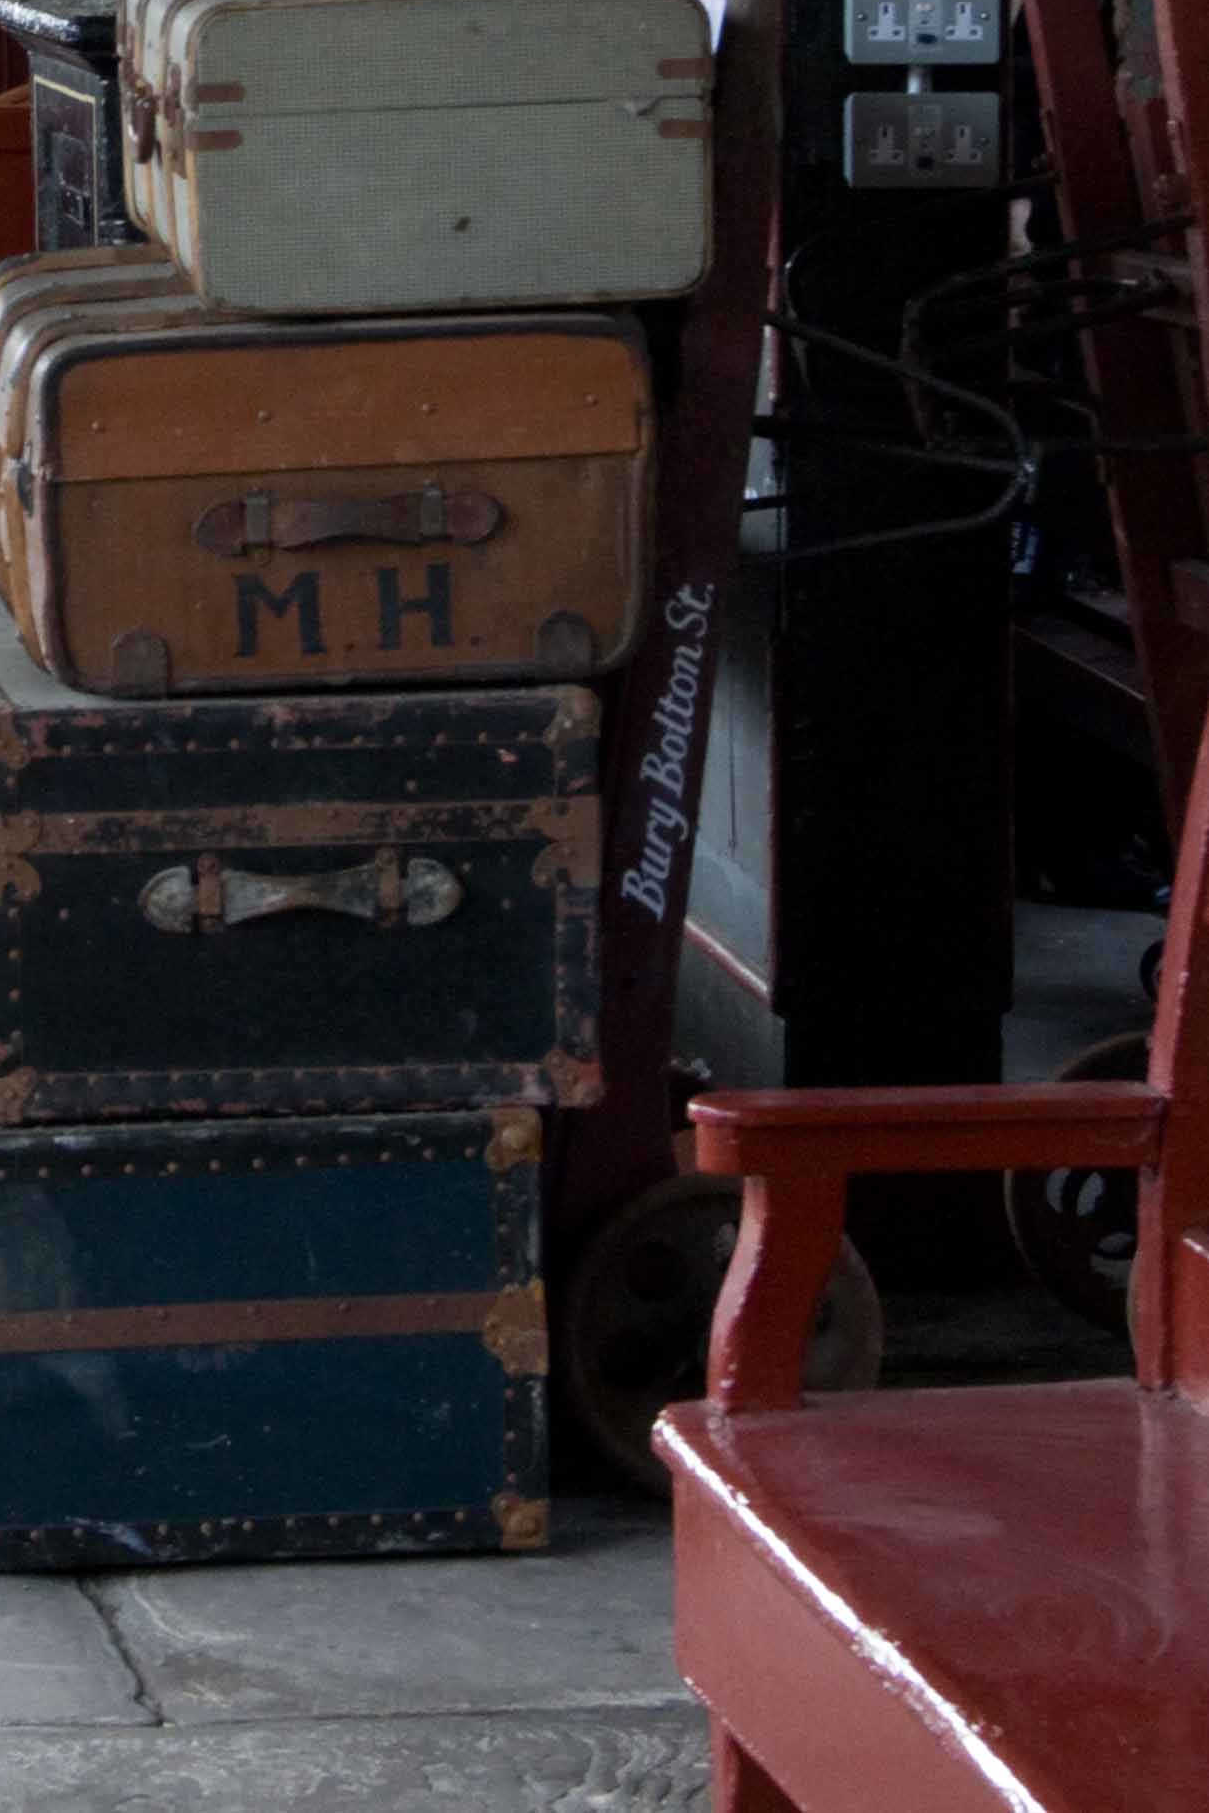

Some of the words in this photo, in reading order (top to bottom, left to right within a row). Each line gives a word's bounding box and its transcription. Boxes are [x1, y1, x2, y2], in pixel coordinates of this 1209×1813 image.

[664, 581, 715, 638] St.
[641, 644, 703, 799] Bolton
[620, 797, 689, 922] Bury
